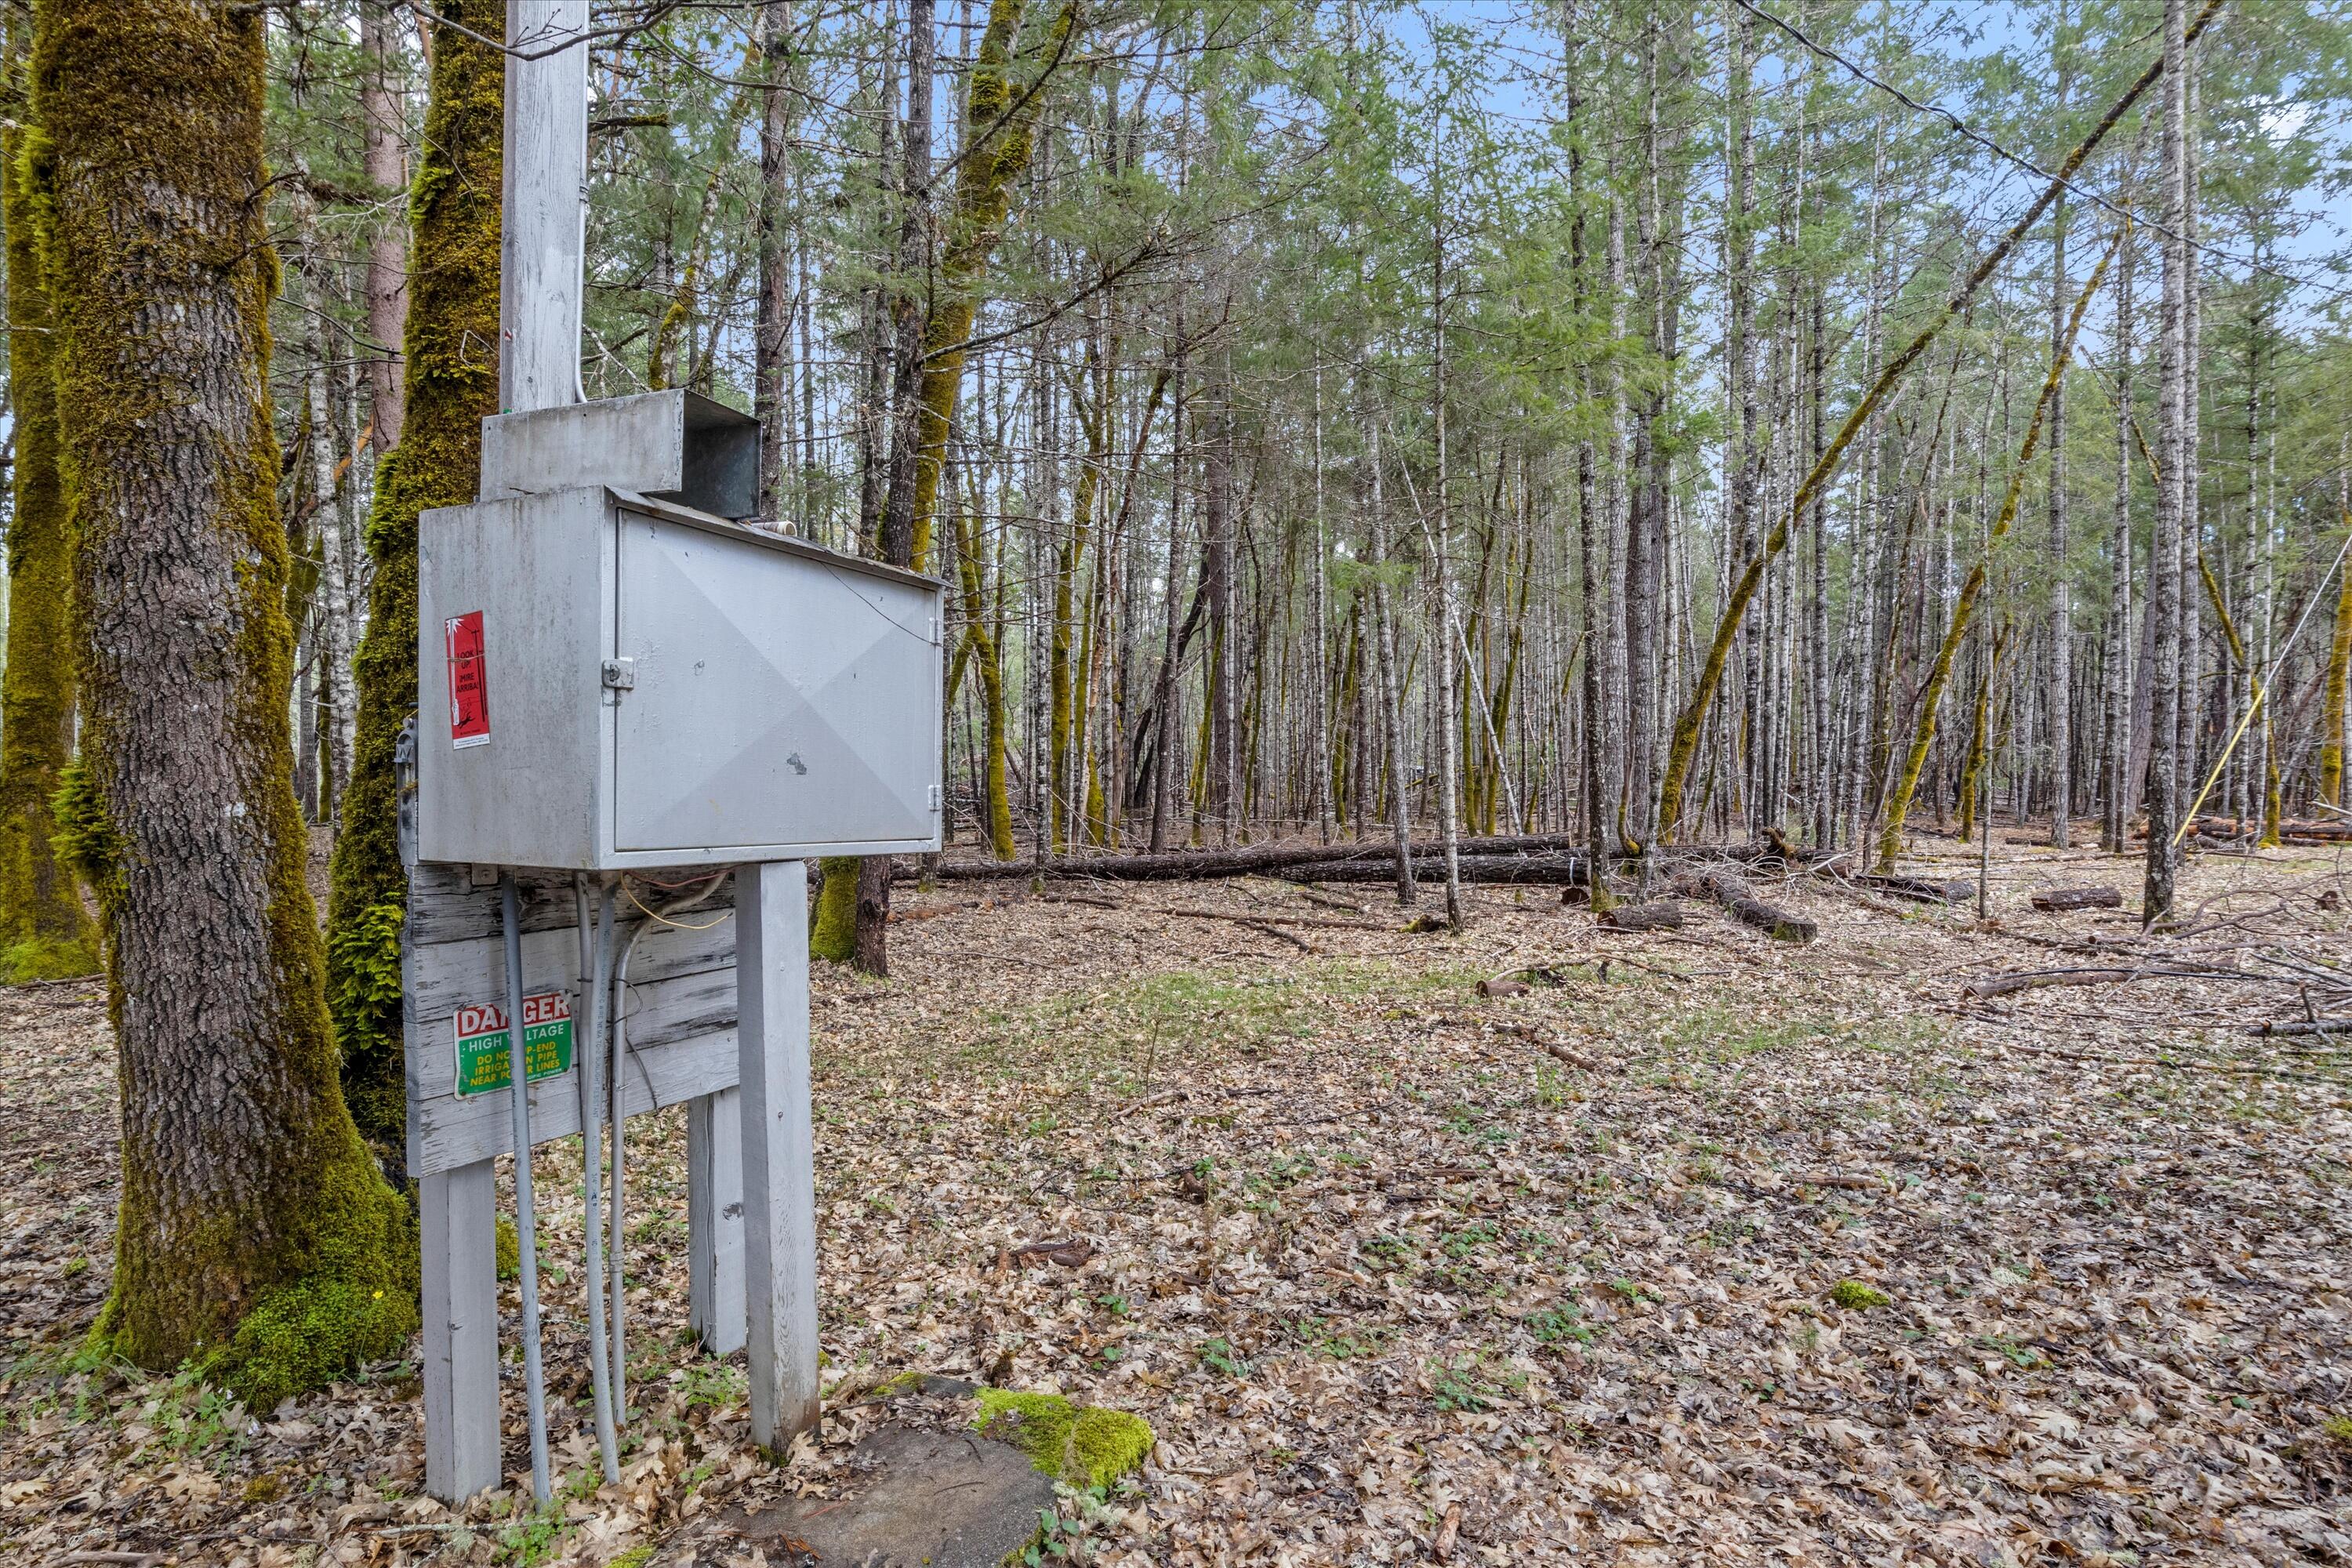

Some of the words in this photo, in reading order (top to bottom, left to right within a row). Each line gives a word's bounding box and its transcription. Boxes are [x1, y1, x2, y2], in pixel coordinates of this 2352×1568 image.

[469, 1036, 502, 1052] HIGH
[477, 1054, 492, 1065] DO
[496, 1051, 510, 1061] NO
[526, 1041, 556, 1054] P-END
[538, 1051, 557, 1062] PIPE
[470, 1074, 496, 1087] NEAR
[537, 1058, 560, 1072] LINES
